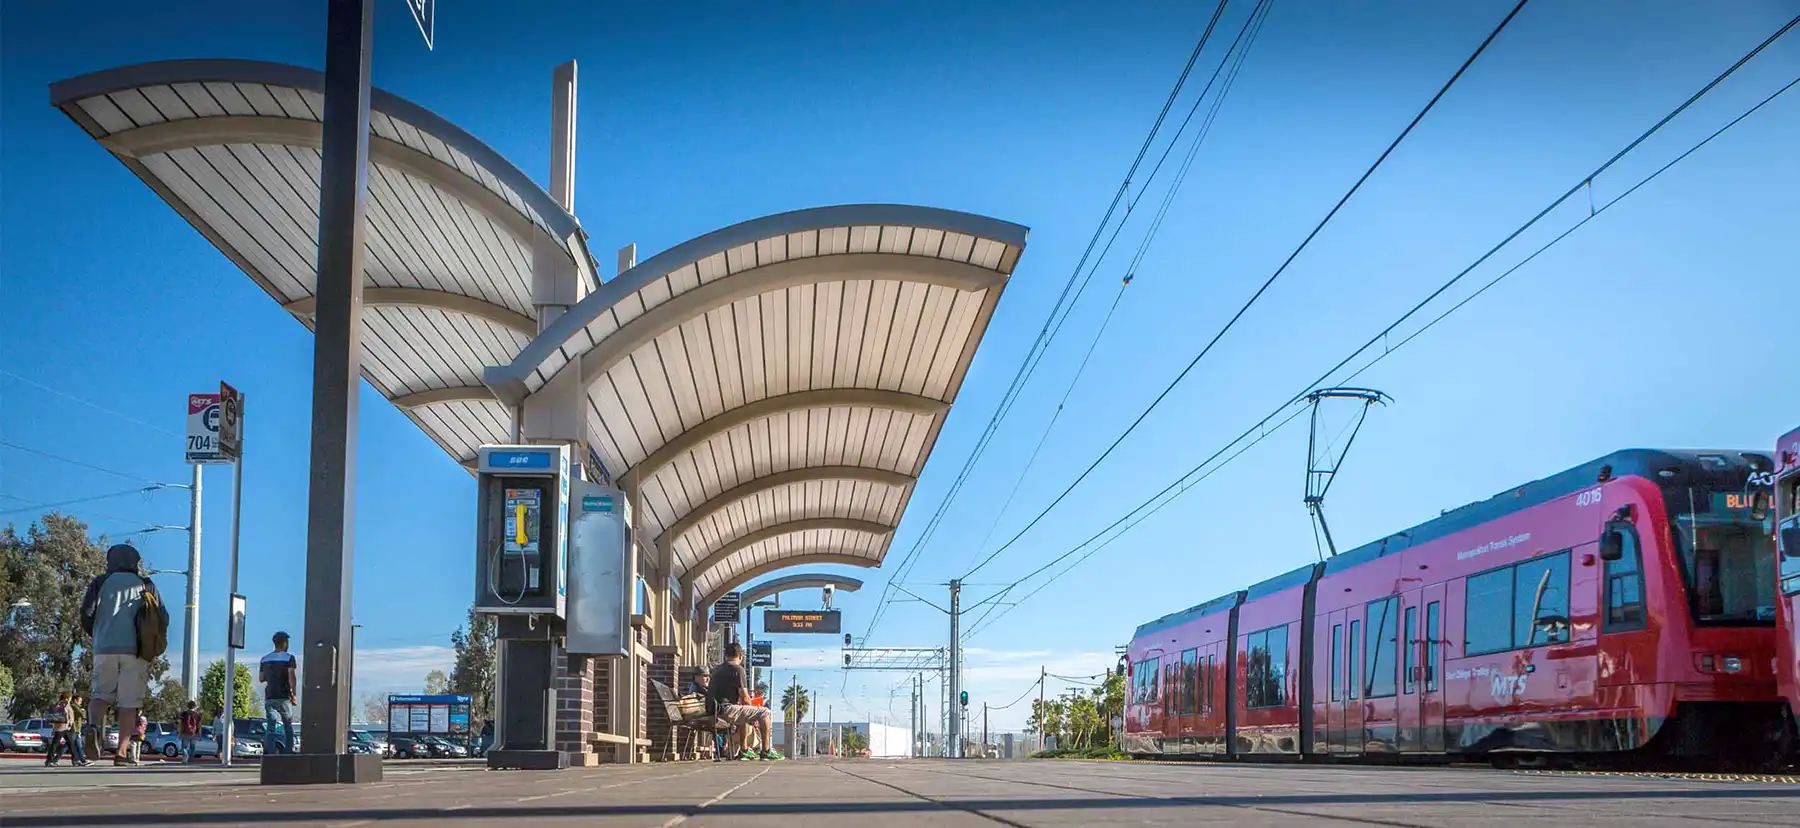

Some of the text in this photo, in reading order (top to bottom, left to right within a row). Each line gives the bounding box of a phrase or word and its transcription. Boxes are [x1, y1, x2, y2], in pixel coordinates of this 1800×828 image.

[188, 435, 211, 450] 704
[1726, 494, 1756, 509] BLU
[1507, 532, 1531, 547] System
[1490, 674, 1528, 697] MTS
